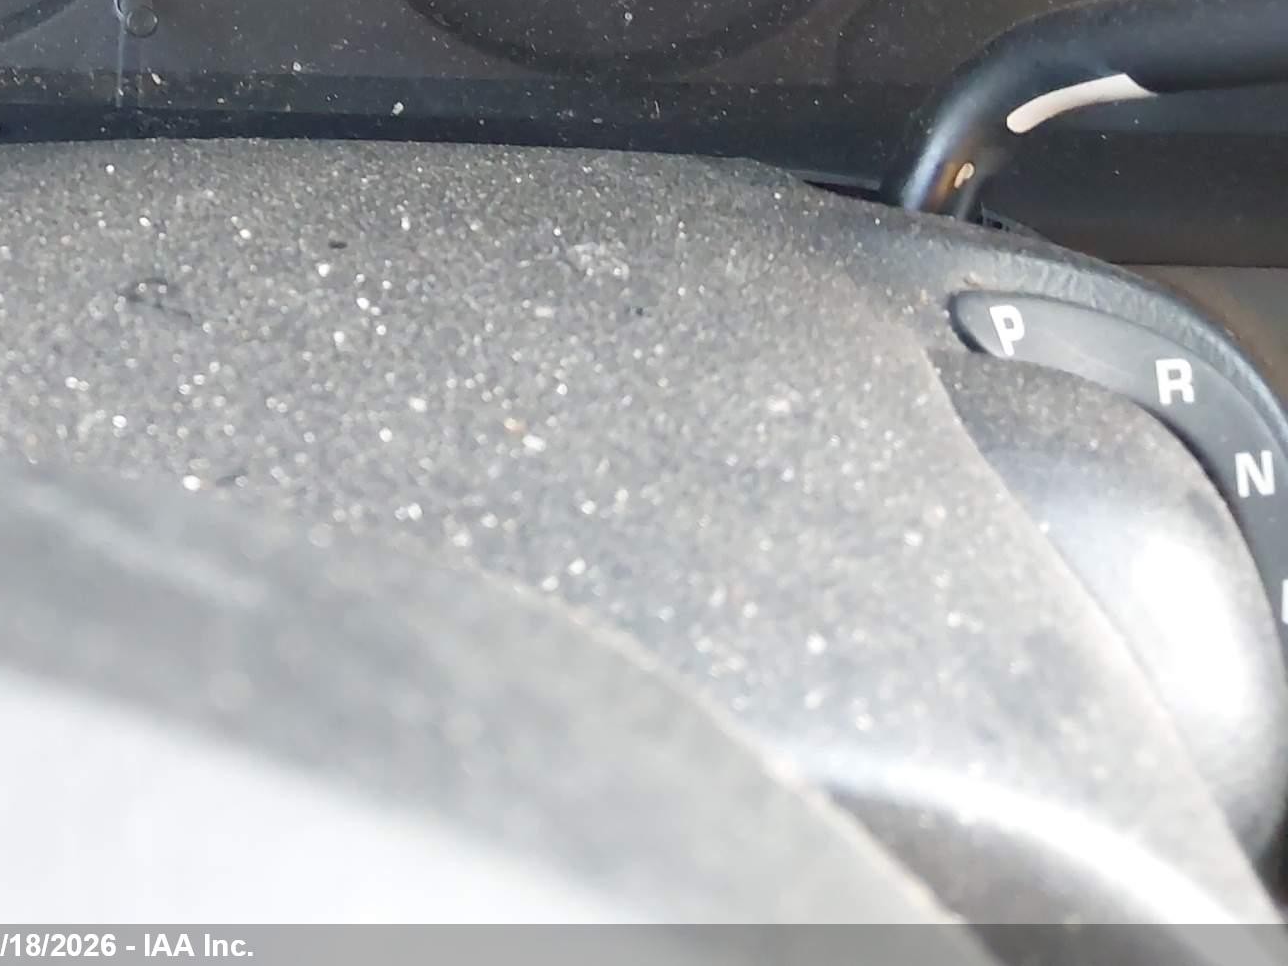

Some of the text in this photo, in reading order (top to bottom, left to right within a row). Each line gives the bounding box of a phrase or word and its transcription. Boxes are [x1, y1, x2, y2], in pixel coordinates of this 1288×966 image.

[989, 304, 1025, 356] P
[1155, 358, 1195, 406] R
[1235, 450, 1275, 498] N
